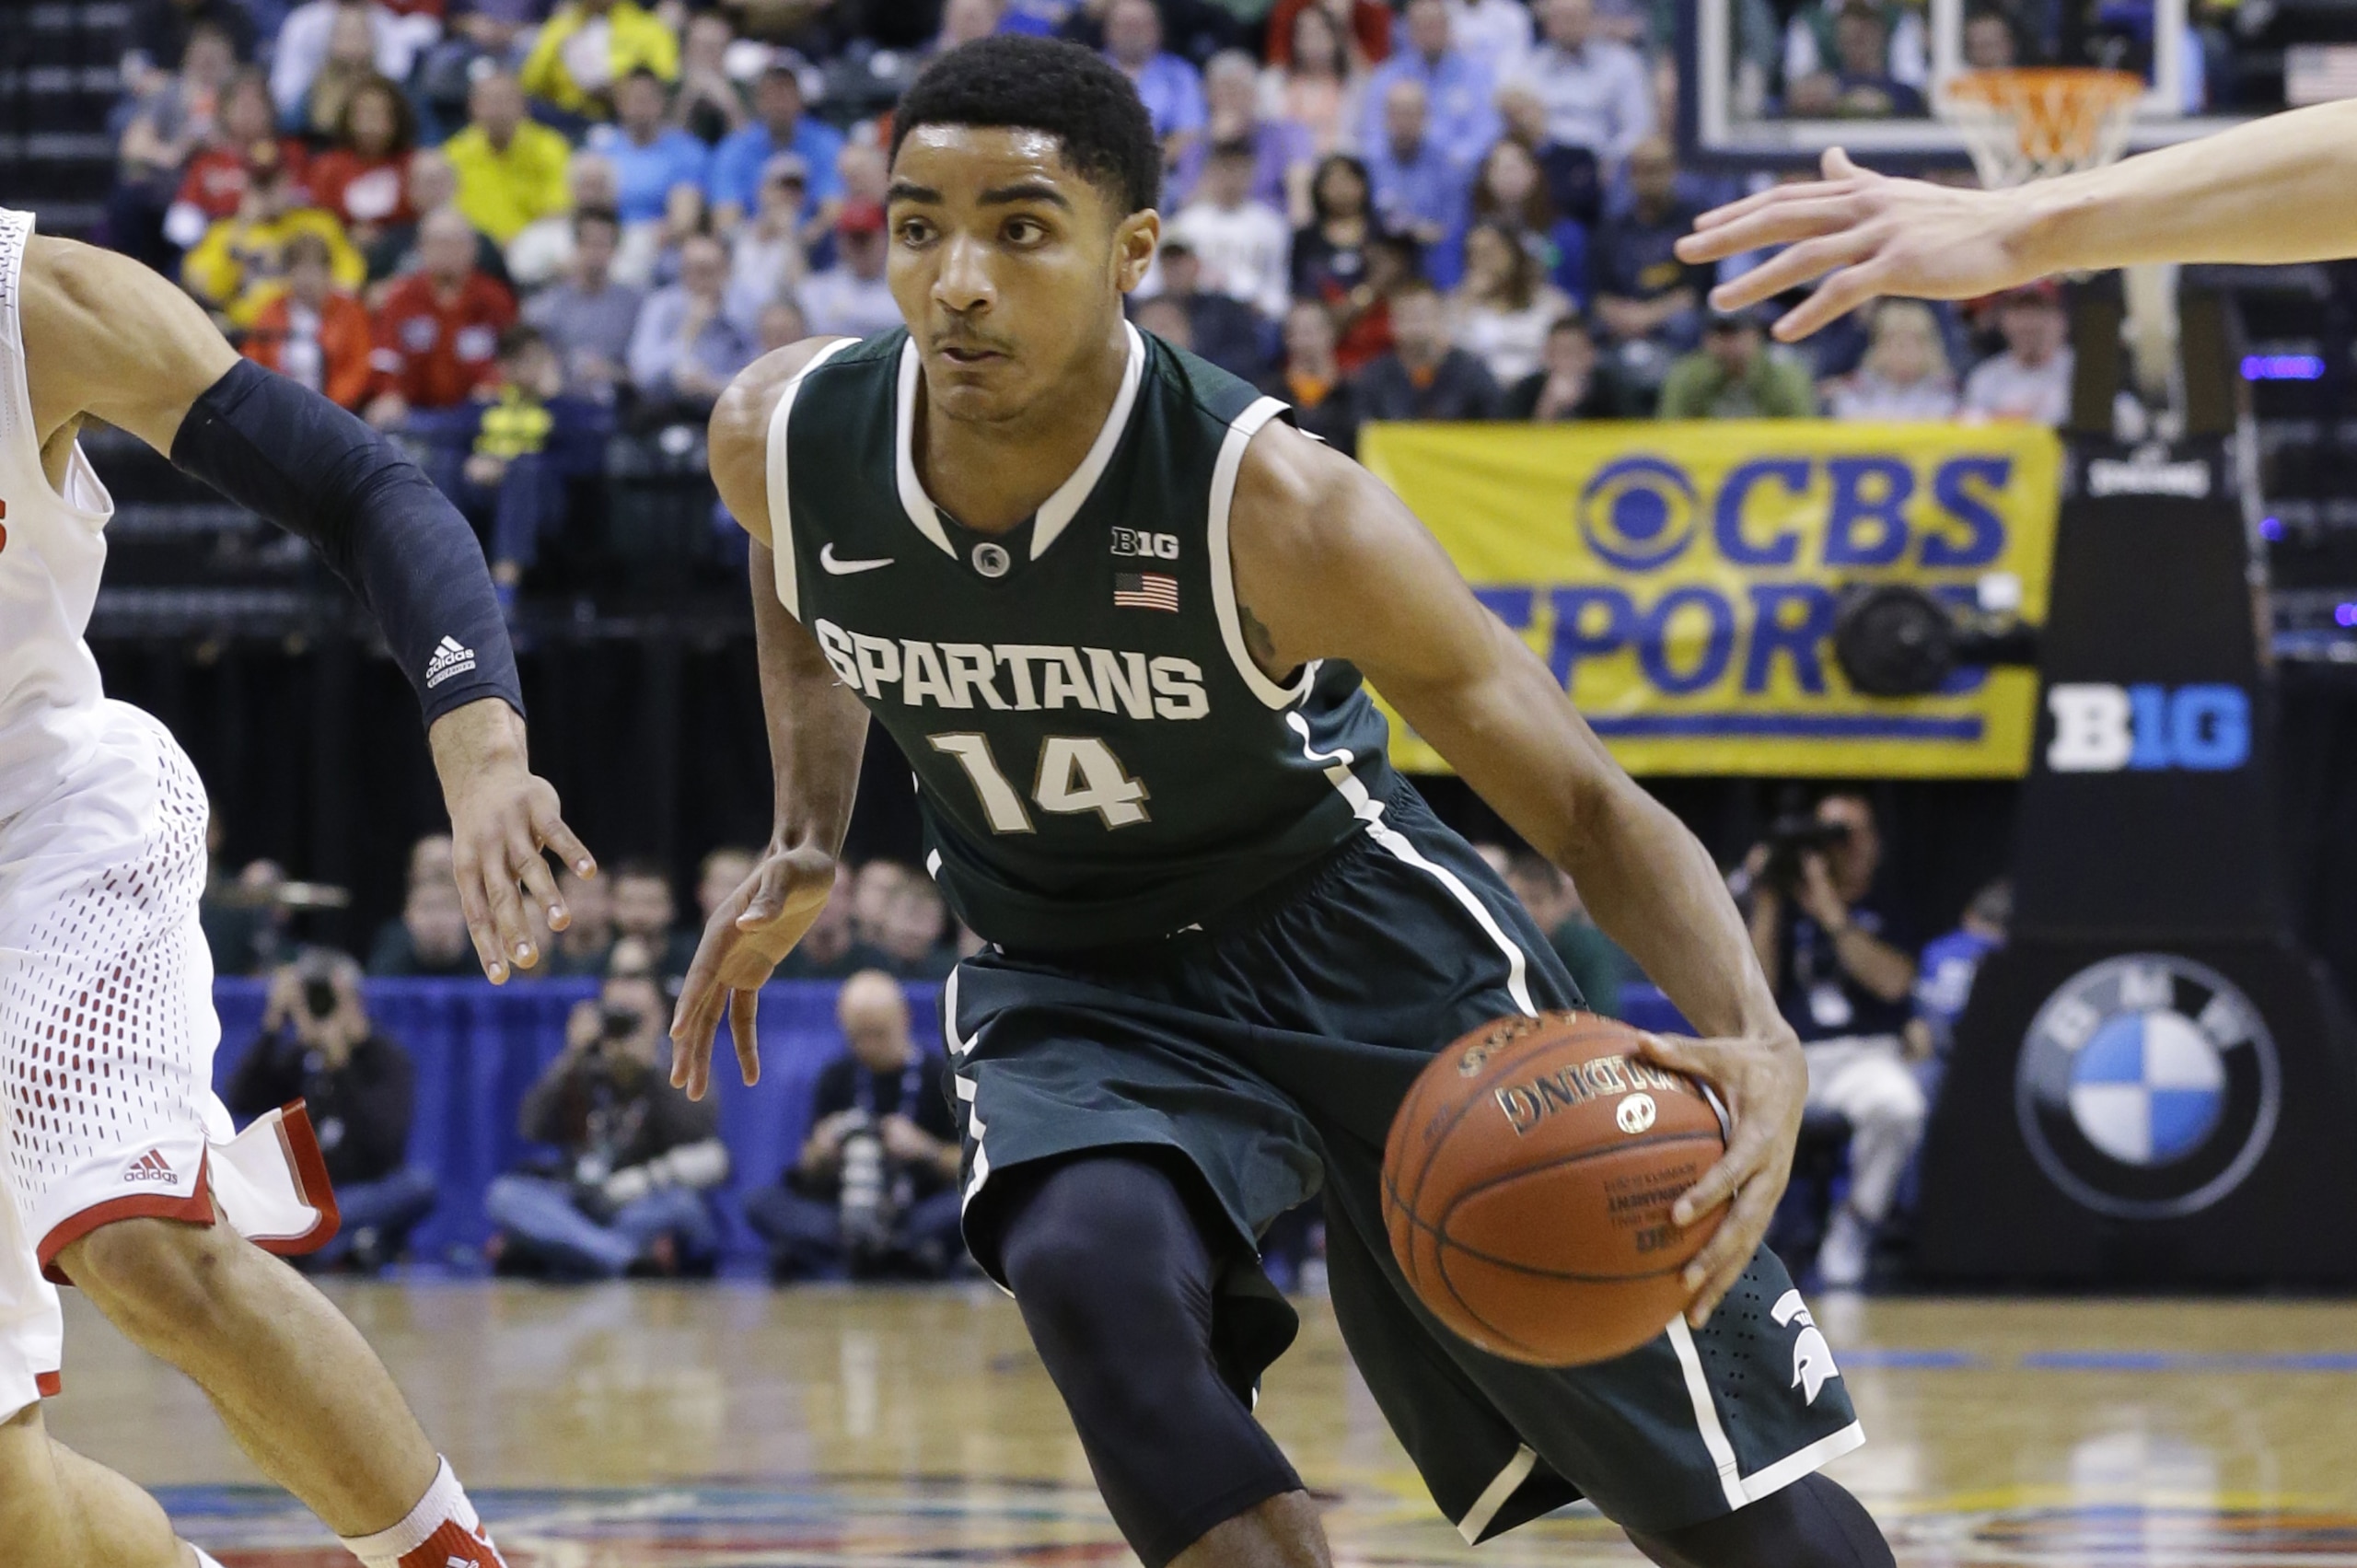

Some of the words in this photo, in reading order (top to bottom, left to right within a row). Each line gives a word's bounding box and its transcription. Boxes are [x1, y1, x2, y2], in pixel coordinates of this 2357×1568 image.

[1110, 526, 1179, 560] BIG
[1712, 457, 2014, 568] CBS
[425, 648, 475, 679] adidas
[815, 618, 1210, 720] SPARTANS
[2047, 682, 2252, 773] BIG
[925, 732, 1152, 834] 14
[2044, 967, 2254, 1051] BMW
[123, 1167, 178, 1185] adidas
